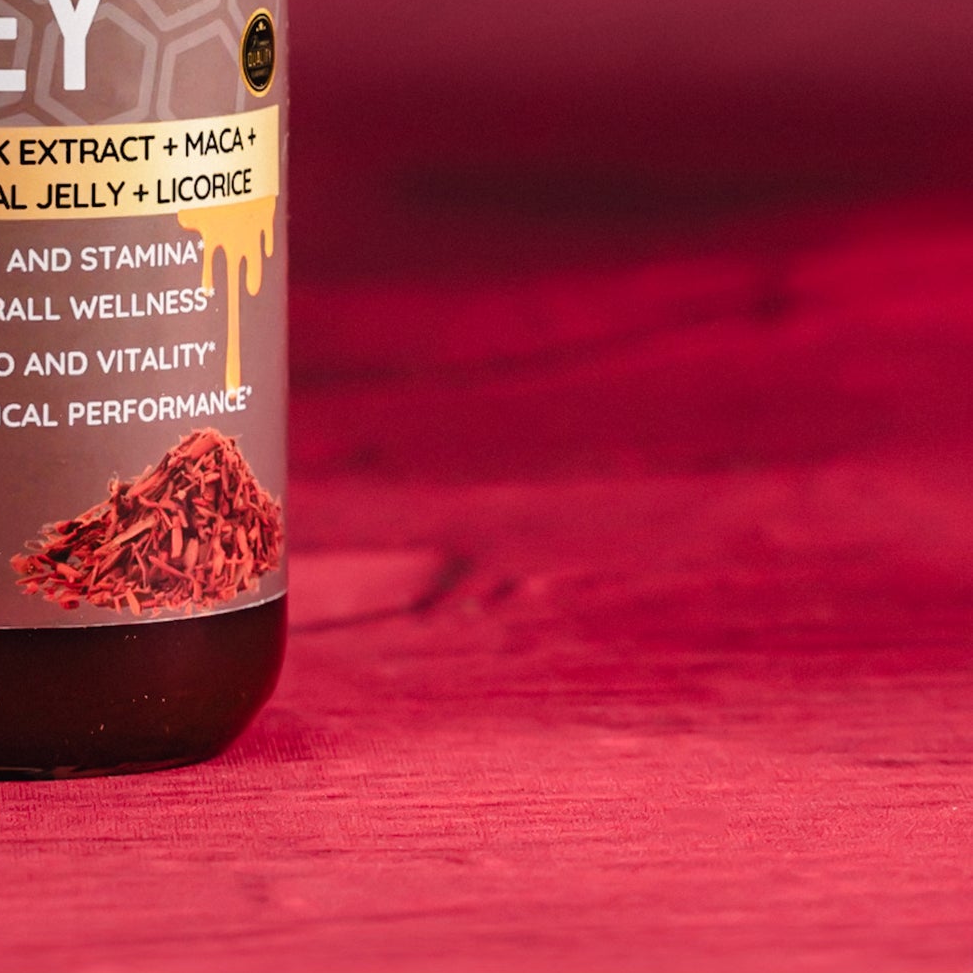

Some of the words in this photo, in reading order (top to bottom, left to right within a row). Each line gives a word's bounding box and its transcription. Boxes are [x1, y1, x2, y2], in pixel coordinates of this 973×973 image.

[19, 135, 155, 166] EXTRACT
[185, 127, 244, 157] MACA
[36, 181, 125, 210] JELLY
[157, 168, 252, 204] LICORICE
[6, 247, 72, 273] AND
[23, 350, 89, 376] AND
